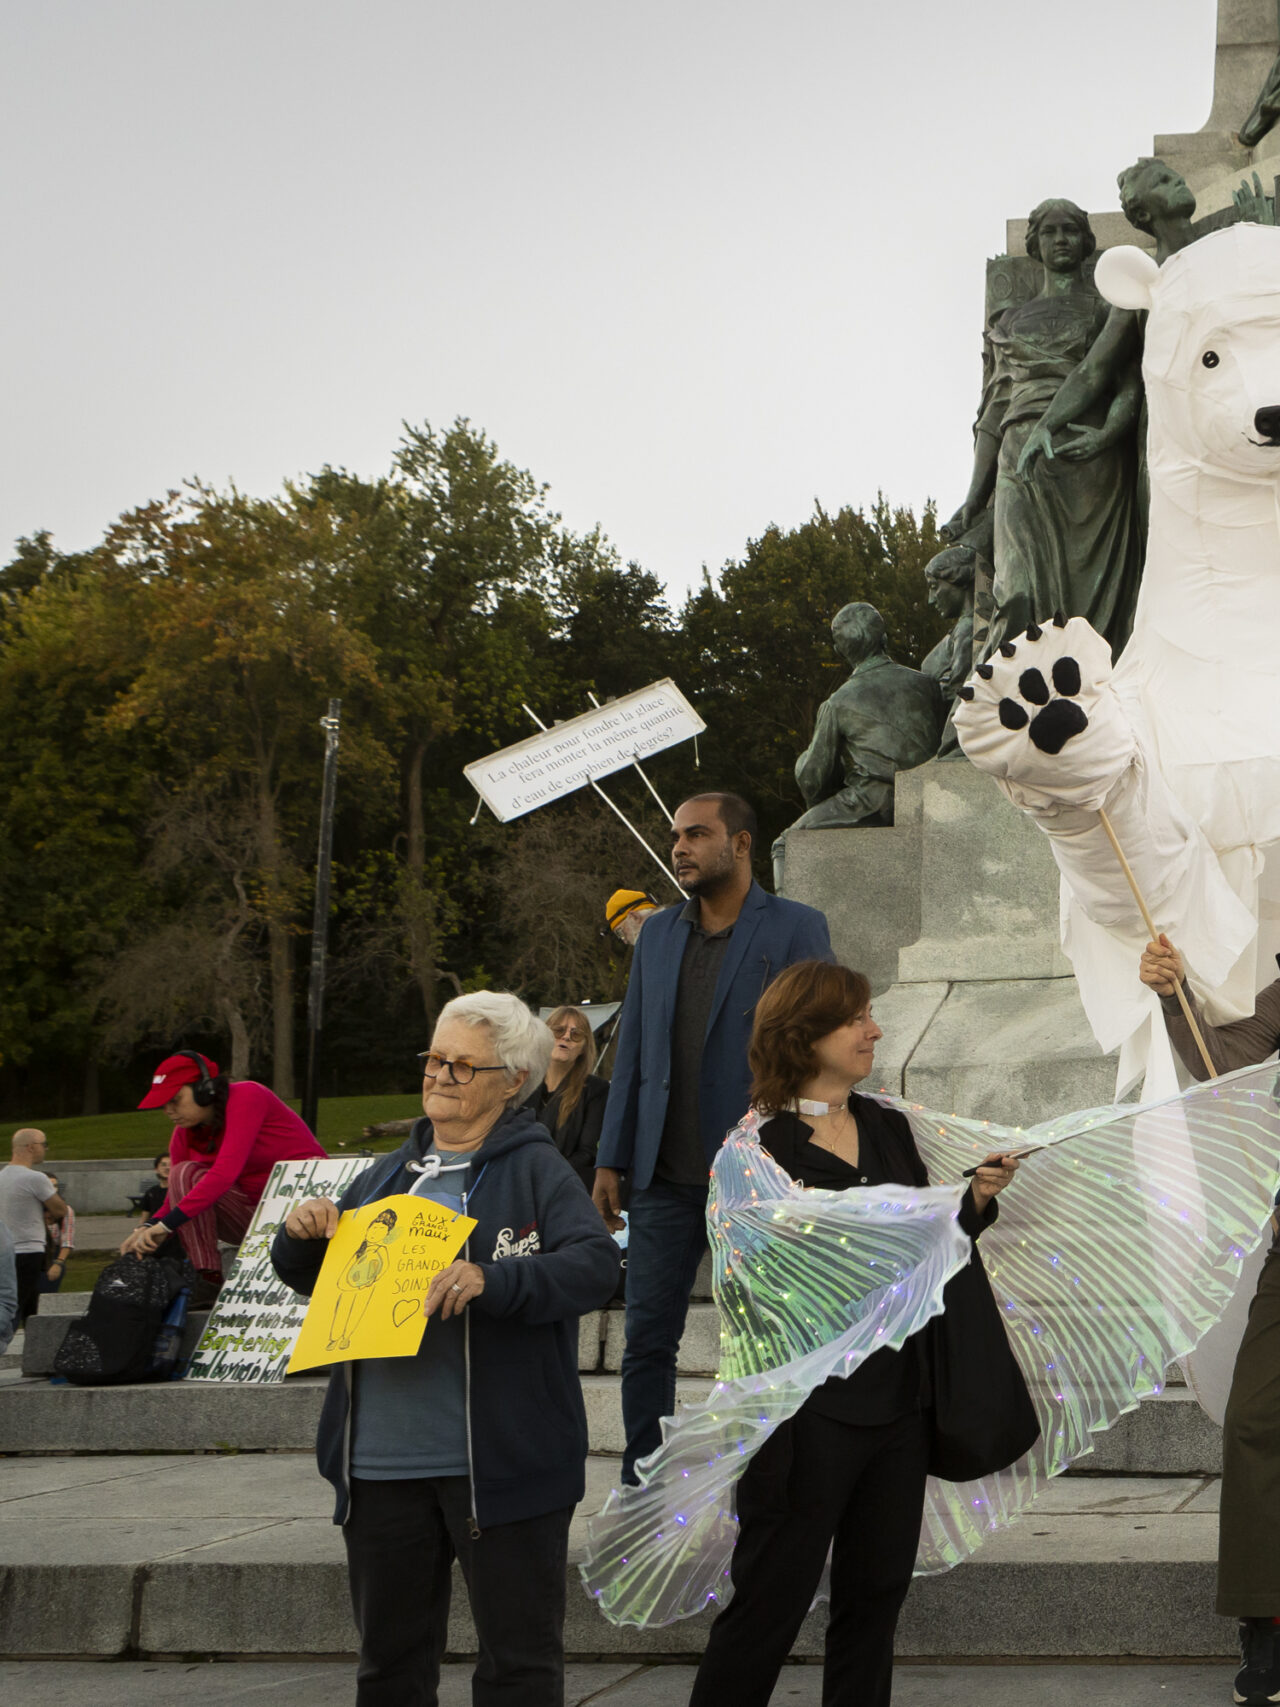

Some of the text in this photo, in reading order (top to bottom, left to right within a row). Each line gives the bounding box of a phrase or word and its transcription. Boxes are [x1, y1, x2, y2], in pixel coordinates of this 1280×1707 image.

[487, 695, 665, 785] La chaleur pour fondre la glace
[518, 703, 686, 786] fera monter la même quantité
[511, 788, 548, 811] d'eau
[549, 775, 564, 792] de
[565, 757, 615, 785] combien
[615, 743, 633, 762] de
[411, 1218, 450, 1234] GRANDS
[414, 1211, 449, 1227] AUX
[402, 1243, 427, 1256] LES
[396, 1258, 447, 1273] GRANDS
[391, 1276, 432, 1295] SOINS
[198, 1326, 293, 1361] Bartering
